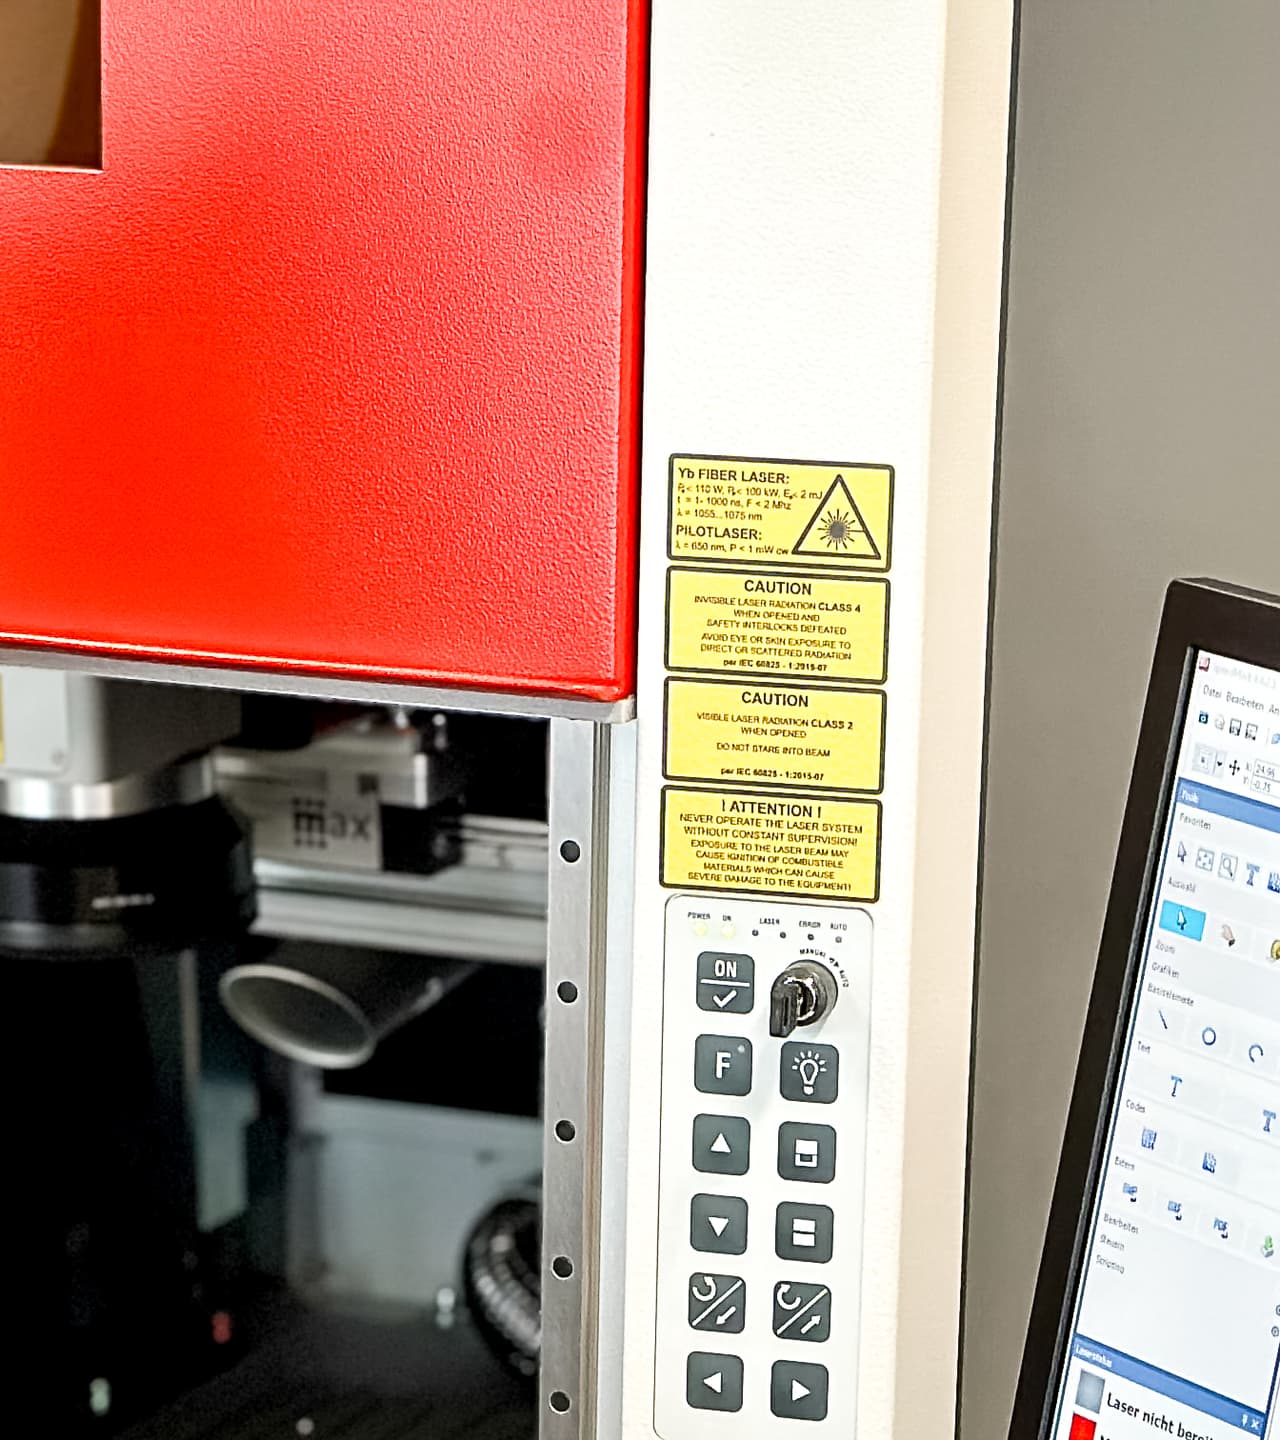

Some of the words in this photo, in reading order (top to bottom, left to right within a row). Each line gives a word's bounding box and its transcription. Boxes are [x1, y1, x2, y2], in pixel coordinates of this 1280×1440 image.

[678, 467, 694, 479] Yb
[698, 468, 737, 481] FIBER
[741, 471, 789, 484] LASER:
[676, 524, 761, 540] PILOTLASER:
[744, 579, 811, 595] CAUTION
[694, 595, 735, 605] INVISIBLE
[737, 598, 766, 607] LASER
[769, 600, 816, 609] RADIATION
[818, 601, 852, 612] CLASS
[854, 604, 860, 613] 4
[733, 609, 760, 618] WHEN
[762, 611, 799, 620] OPENED
[801, 614, 820, 622] AND
[706, 618, 740, 628] SAFETY
[742, 621, 798, 631] INTERLOCKS
[800, 624, 846, 635] DEFEATED
[701, 632, 728, 641] AVOID
[730, 634, 746, 642] EYE
[765, 636, 786, 645] SKIN
[788, 638, 835, 649] EXPOSURE
[700, 643, 732, 653] DIRECT
[750, 647, 802, 657] SCATTERED
[804, 649, 851, 660] RADIATION
[741, 691, 808, 707] CAUTION
[1203, 684, 1221, 698] Datei
[696, 712, 728, 721] VISIBLE
[731, 714, 759, 723] LASER
[762, 716, 808, 727] RADIATION
[810, 718, 844, 729] CLASS
[847, 721, 853, 730] 2
[741, 726, 767, 735] WHEN
[769, 728, 806, 738] OPENED
[731, 743, 749, 751] NOT
[752, 744, 779, 754] STARE
[782, 747, 803, 755] INTO
[805, 748, 830, 757] BEAM
[729, 800, 812, 817] ATTENTION
[679, 813, 713, 823] NEVER
[715, 815, 761, 827] OPERATE
[765, 819, 783, 828] THE
[786, 821, 818, 830] LASER
[822, 823, 862, 833] SYSTEM
[683, 826, 729, 837] WITHOUT
[731, 829, 784, 841] CONSTANT
[787, 833, 857, 846] SUPERVISION!
[690, 839, 737, 850] EXPOSURE
[755, 843, 770, 852] THE
[773, 845, 801, 854] LASER
[804, 847, 828, 856] BEAM
[831, 849, 848, 857] MAY
[695, 850, 724, 860] CAUSE
[727, 853, 765, 862] IGNITION
[781, 856, 843, 868] COMBUSTIBLE
[703, 862, 751, 873] MATERIALS
[753, 866, 783, 875] WHICH
[784, 868, 803, 876] CAN
[805, 869, 834, 879] CAUSE
[688, 871, 721, 881] SEVERE
[724, 874, 761, 884] DAMAGE
[778, 878, 794, 887] THE
[797, 880, 851, 891] EQUIPMENT!
[799, 920, 821, 929] ERROR
[830, 923, 847, 931] AUTO
[714, 960, 737, 978] ON
[715, 1051, 732, 1079] F
[1107, 1392, 1139, 1417] Laser
[1142, 1412, 1174, 1434] nicht
